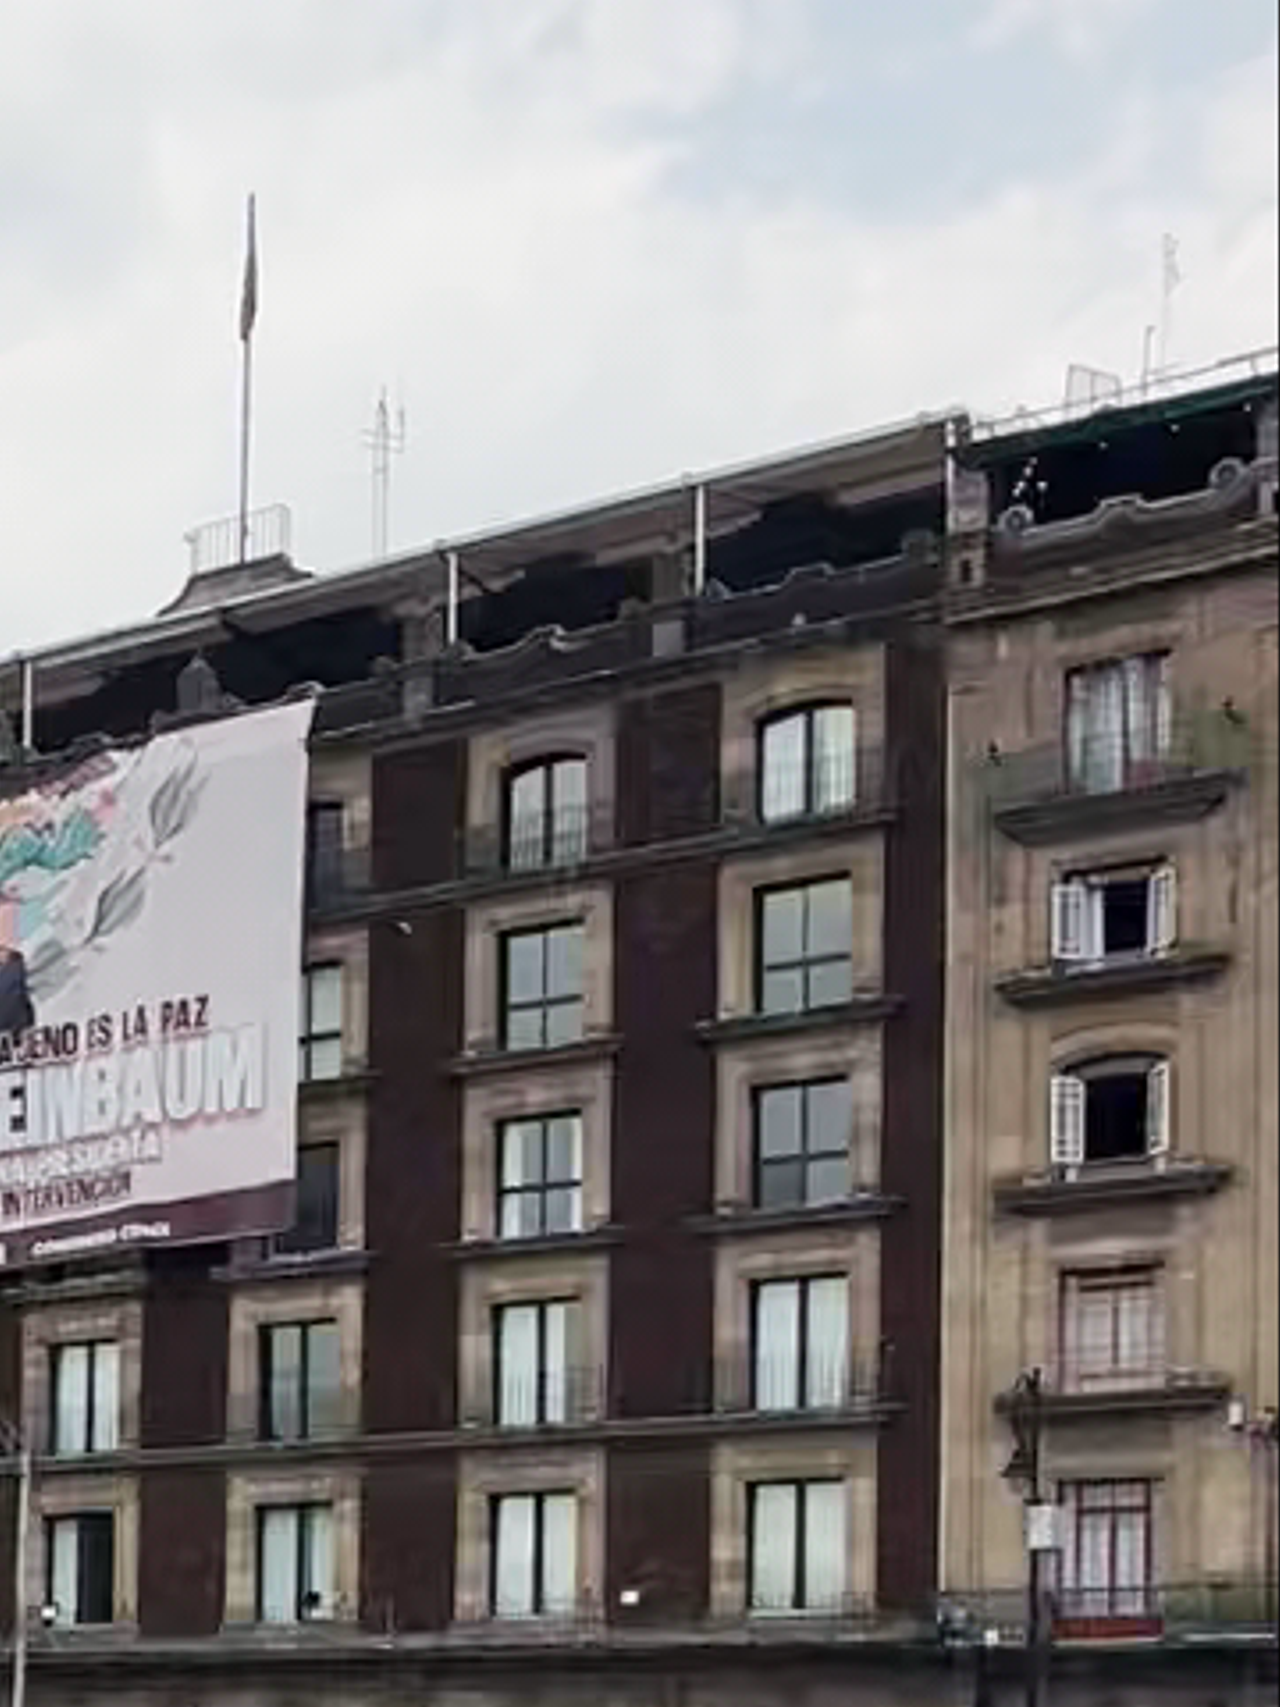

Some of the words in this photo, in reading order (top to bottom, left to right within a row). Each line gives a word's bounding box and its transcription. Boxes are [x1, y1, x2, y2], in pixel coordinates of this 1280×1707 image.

[86, 1014, 113, 1049] ES
[121, 1002, 149, 1041] LA
[160, 993, 210, 1034] PAZ
